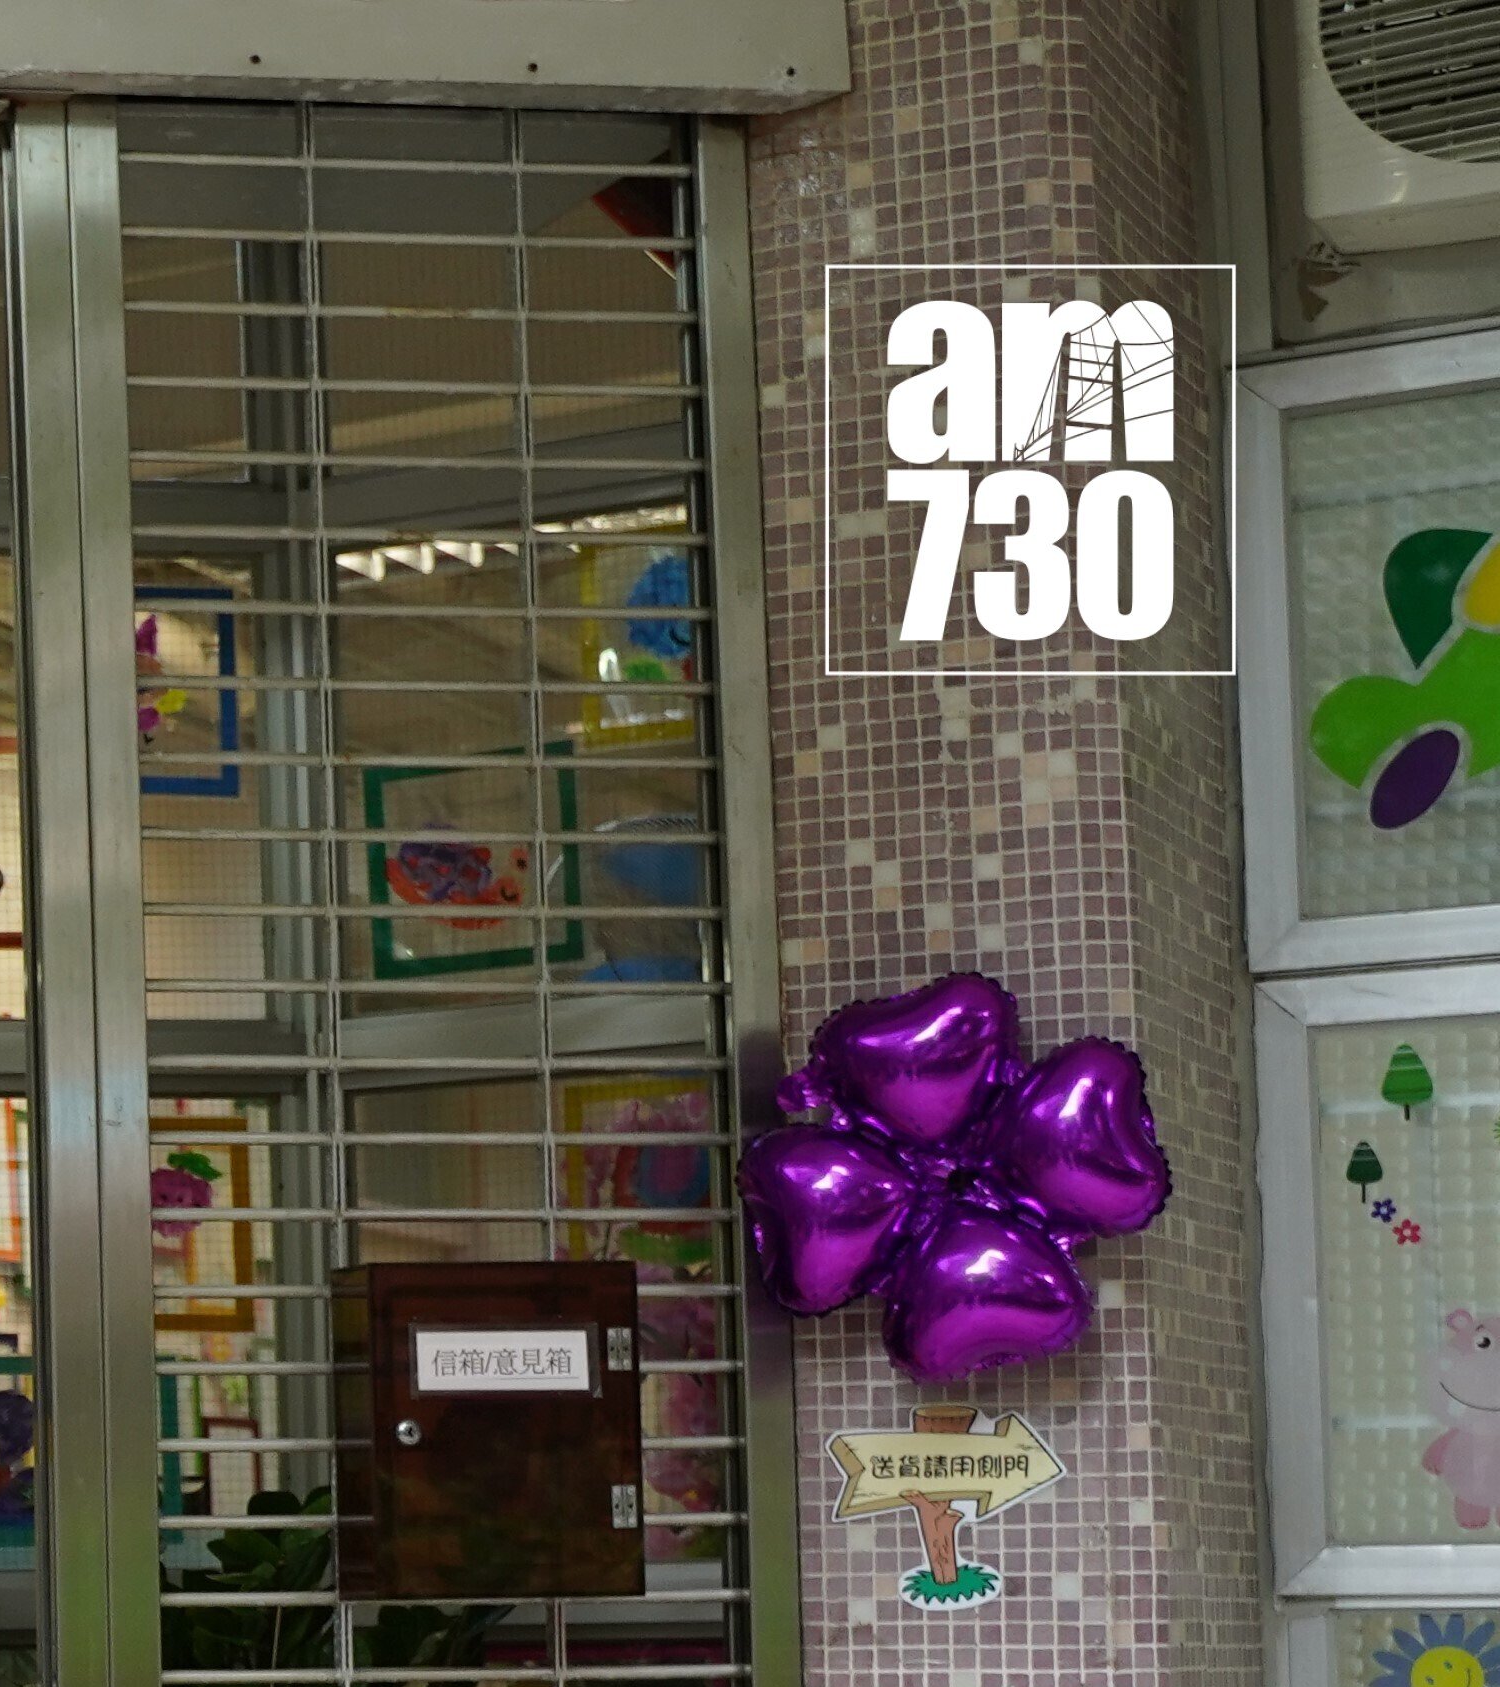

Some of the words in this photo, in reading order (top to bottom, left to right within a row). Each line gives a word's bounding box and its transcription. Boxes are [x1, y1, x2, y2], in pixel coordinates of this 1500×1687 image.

[432, 1348, 572, 1377] 信箱/意見箱
[870, 1454, 1029, 1479] 送貨請用側門
